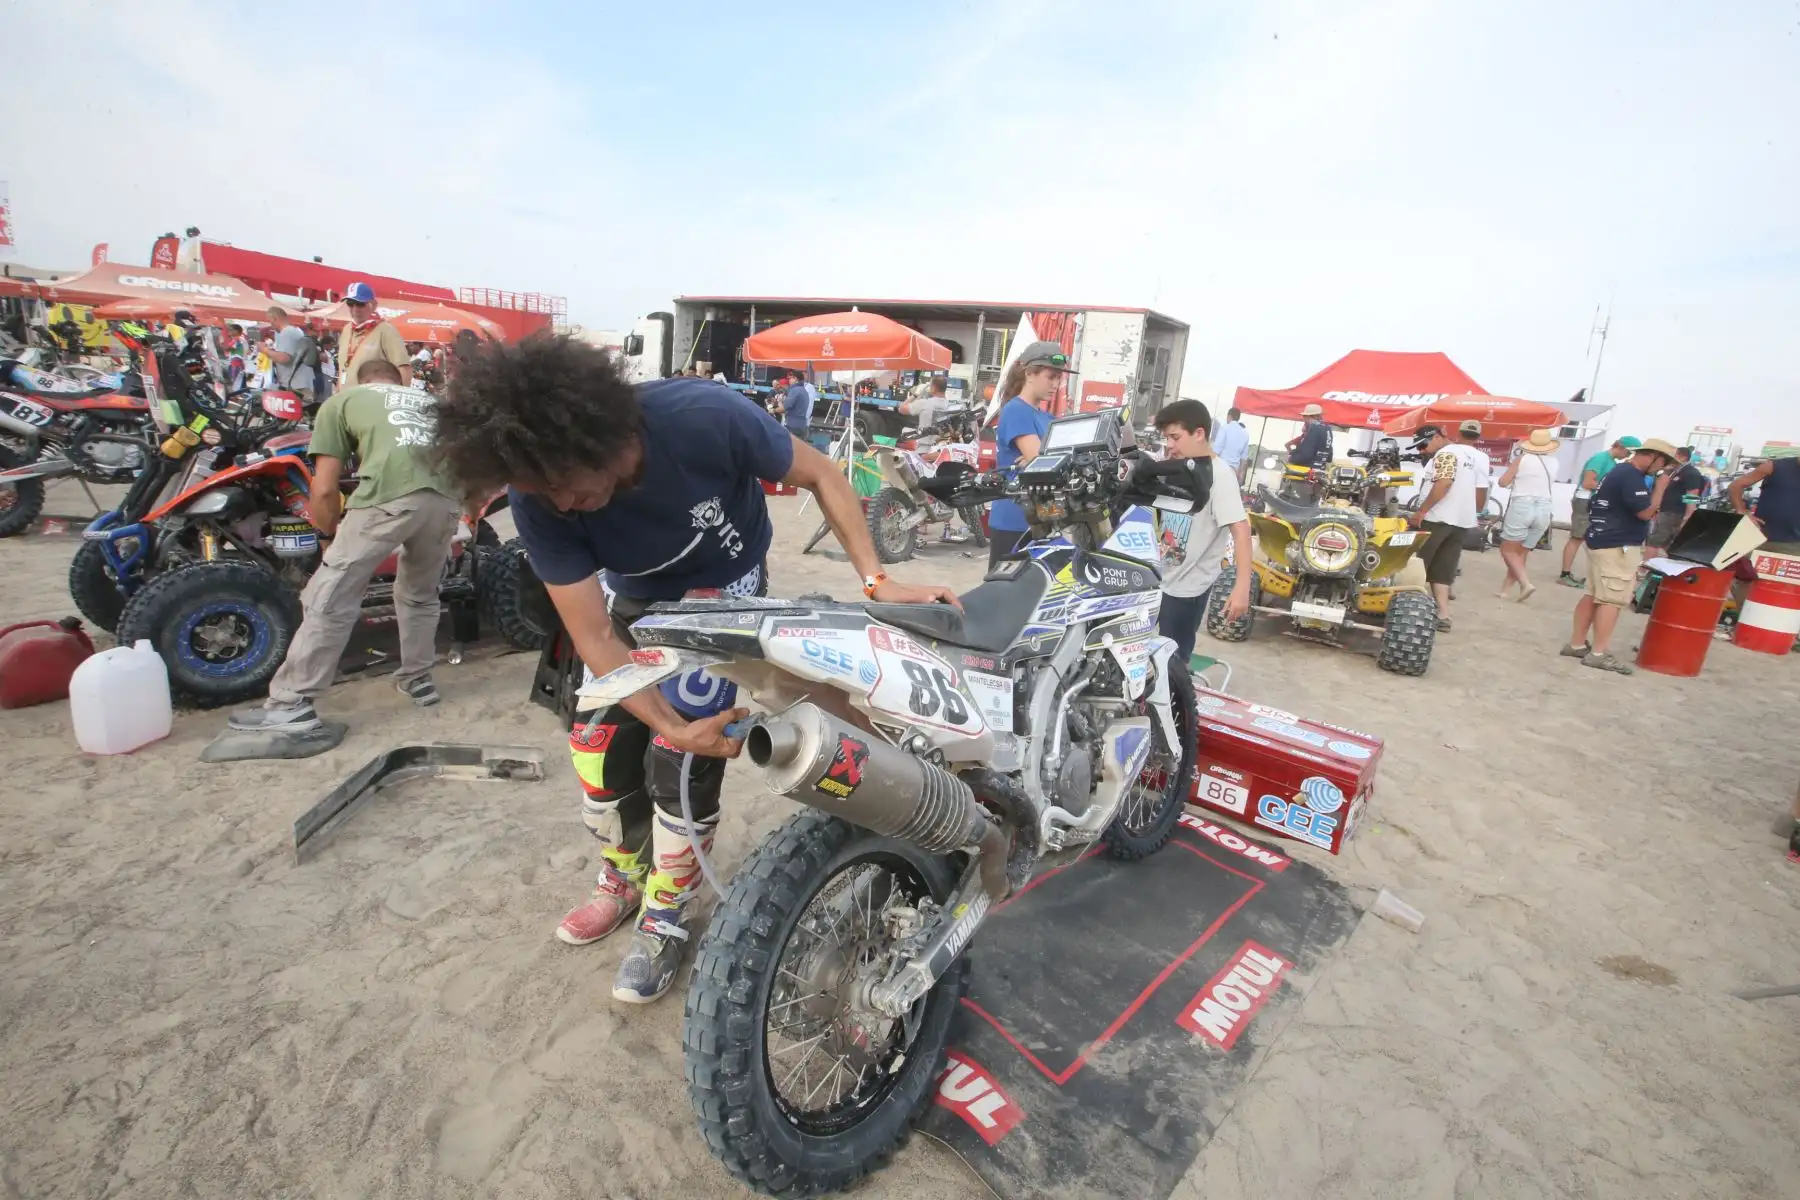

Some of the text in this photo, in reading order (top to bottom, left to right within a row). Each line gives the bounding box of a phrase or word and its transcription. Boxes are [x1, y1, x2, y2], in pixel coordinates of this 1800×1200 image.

[118, 274, 240, 297] ORIGINAL
[796, 324, 869, 335] MOTUL
[1321, 390, 1449, 407] ORIGINA
[1116, 531, 1151, 549] GEE
[1103, 567, 1127, 578] PONT
[1104, 576, 1129, 588] GRUP
[801, 640, 854, 671] GEE
[900, 660, 969, 725] 86
[1209, 765, 1244, 781] ORIGINAL
[1207, 781, 1237, 805] 86
[1257, 795, 1338, 842] GEE
[1177, 812, 1283, 865] MOTU
[1191, 948, 1283, 1042] MOTUL
